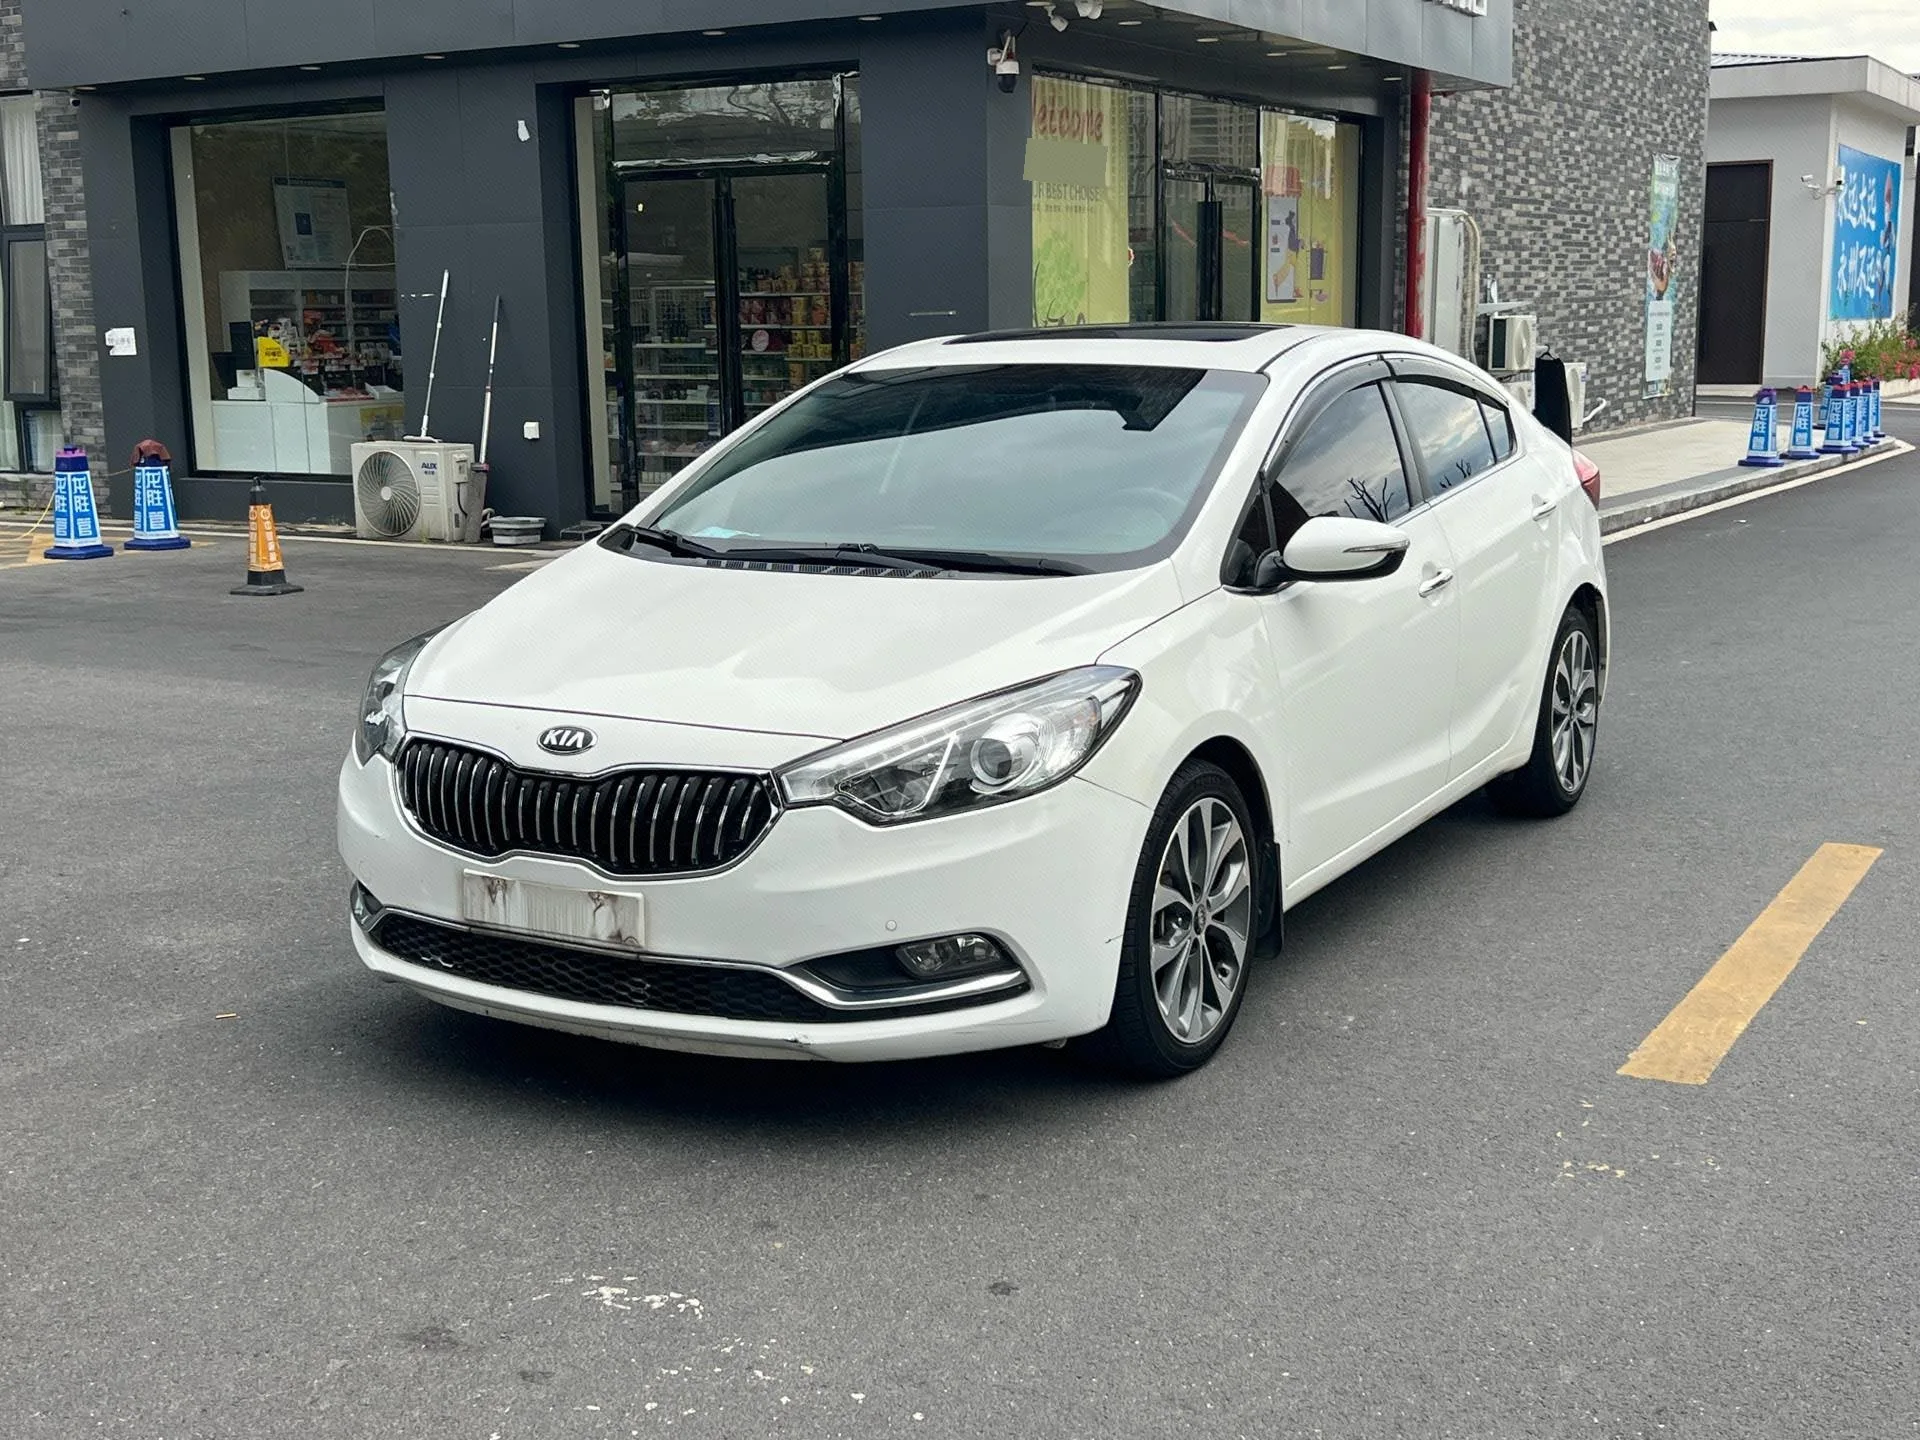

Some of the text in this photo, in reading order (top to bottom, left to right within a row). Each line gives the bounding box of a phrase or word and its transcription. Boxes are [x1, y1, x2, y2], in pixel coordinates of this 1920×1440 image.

[1032, 81, 1104, 142] elcome
[1046, 183, 1067, 200] BEST
[543, 729, 585, 748] KIA
